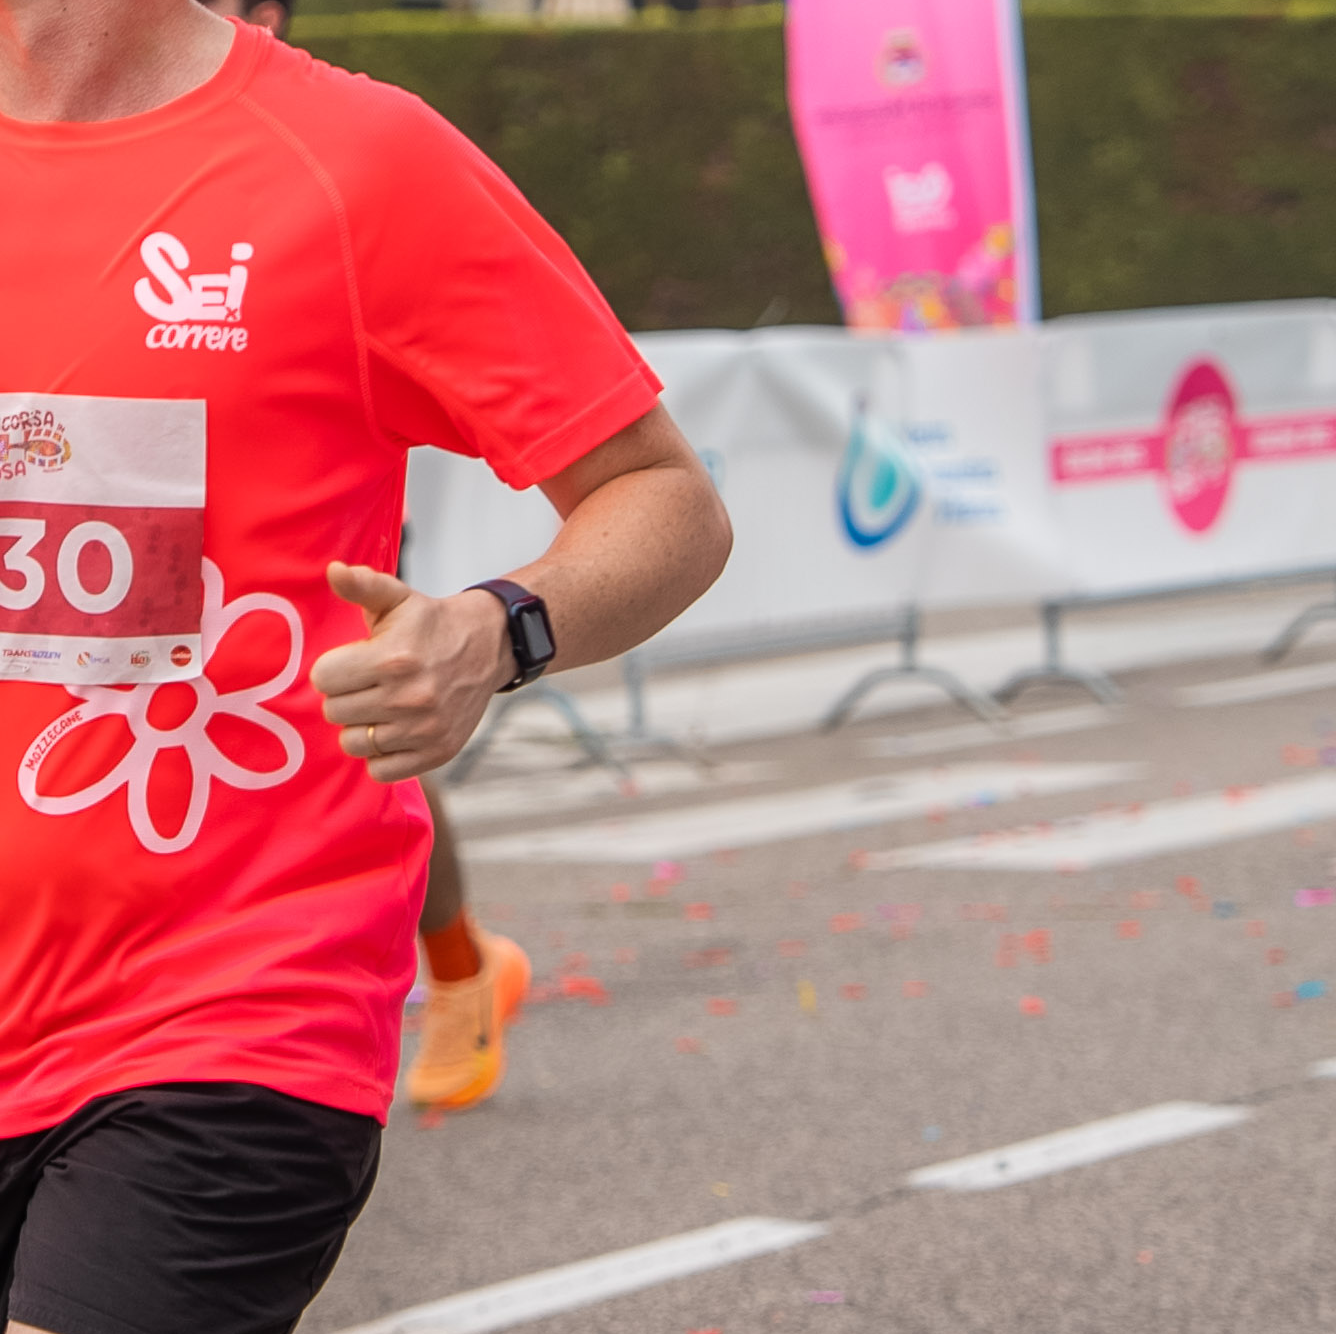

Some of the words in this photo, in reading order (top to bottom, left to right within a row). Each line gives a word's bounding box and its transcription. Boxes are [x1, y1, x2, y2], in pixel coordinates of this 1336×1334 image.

[145, 323, 248, 352] correre
[2, 410, 54, 431] CORSA
[25, 710, 84, 772] MOZZECANE
